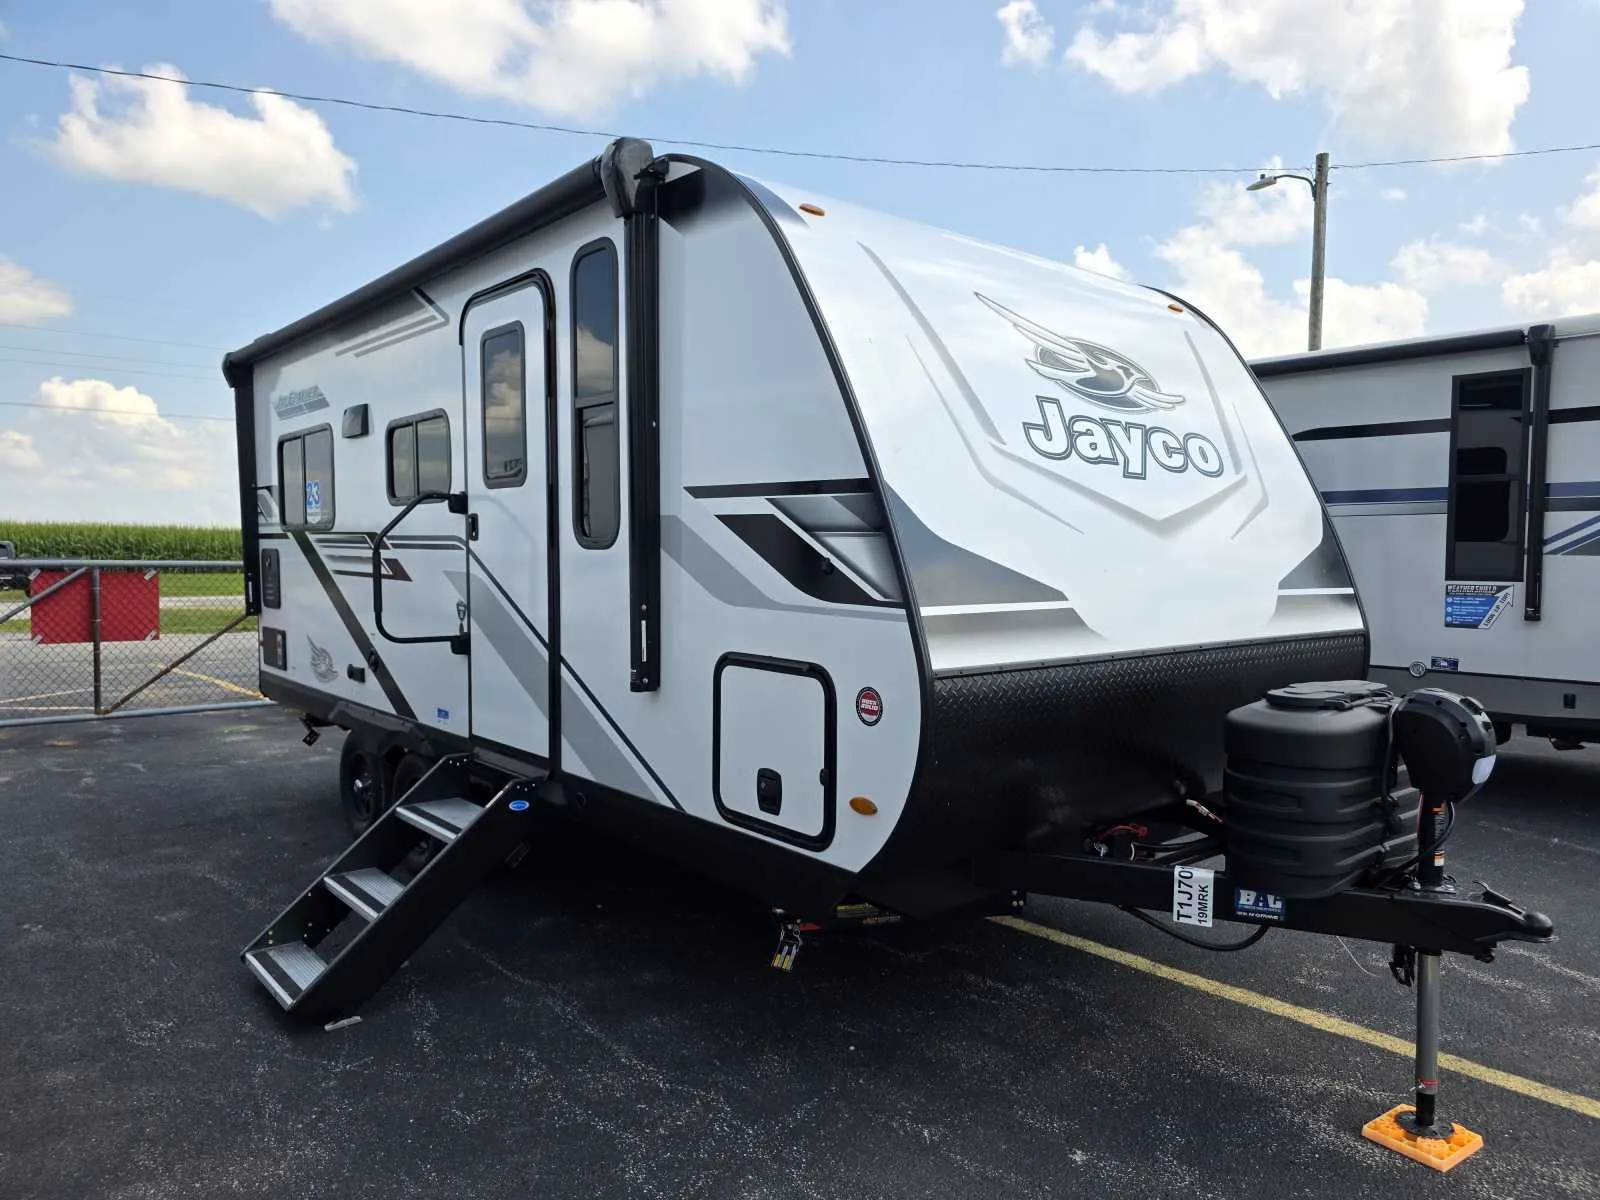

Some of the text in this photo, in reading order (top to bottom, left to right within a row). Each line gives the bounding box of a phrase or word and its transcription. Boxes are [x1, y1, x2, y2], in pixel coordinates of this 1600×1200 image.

[1022, 395, 1224, 480] Jayco
[1176, 866, 1194, 921] T1J70
[1197, 884, 1209, 924] 19MRK
